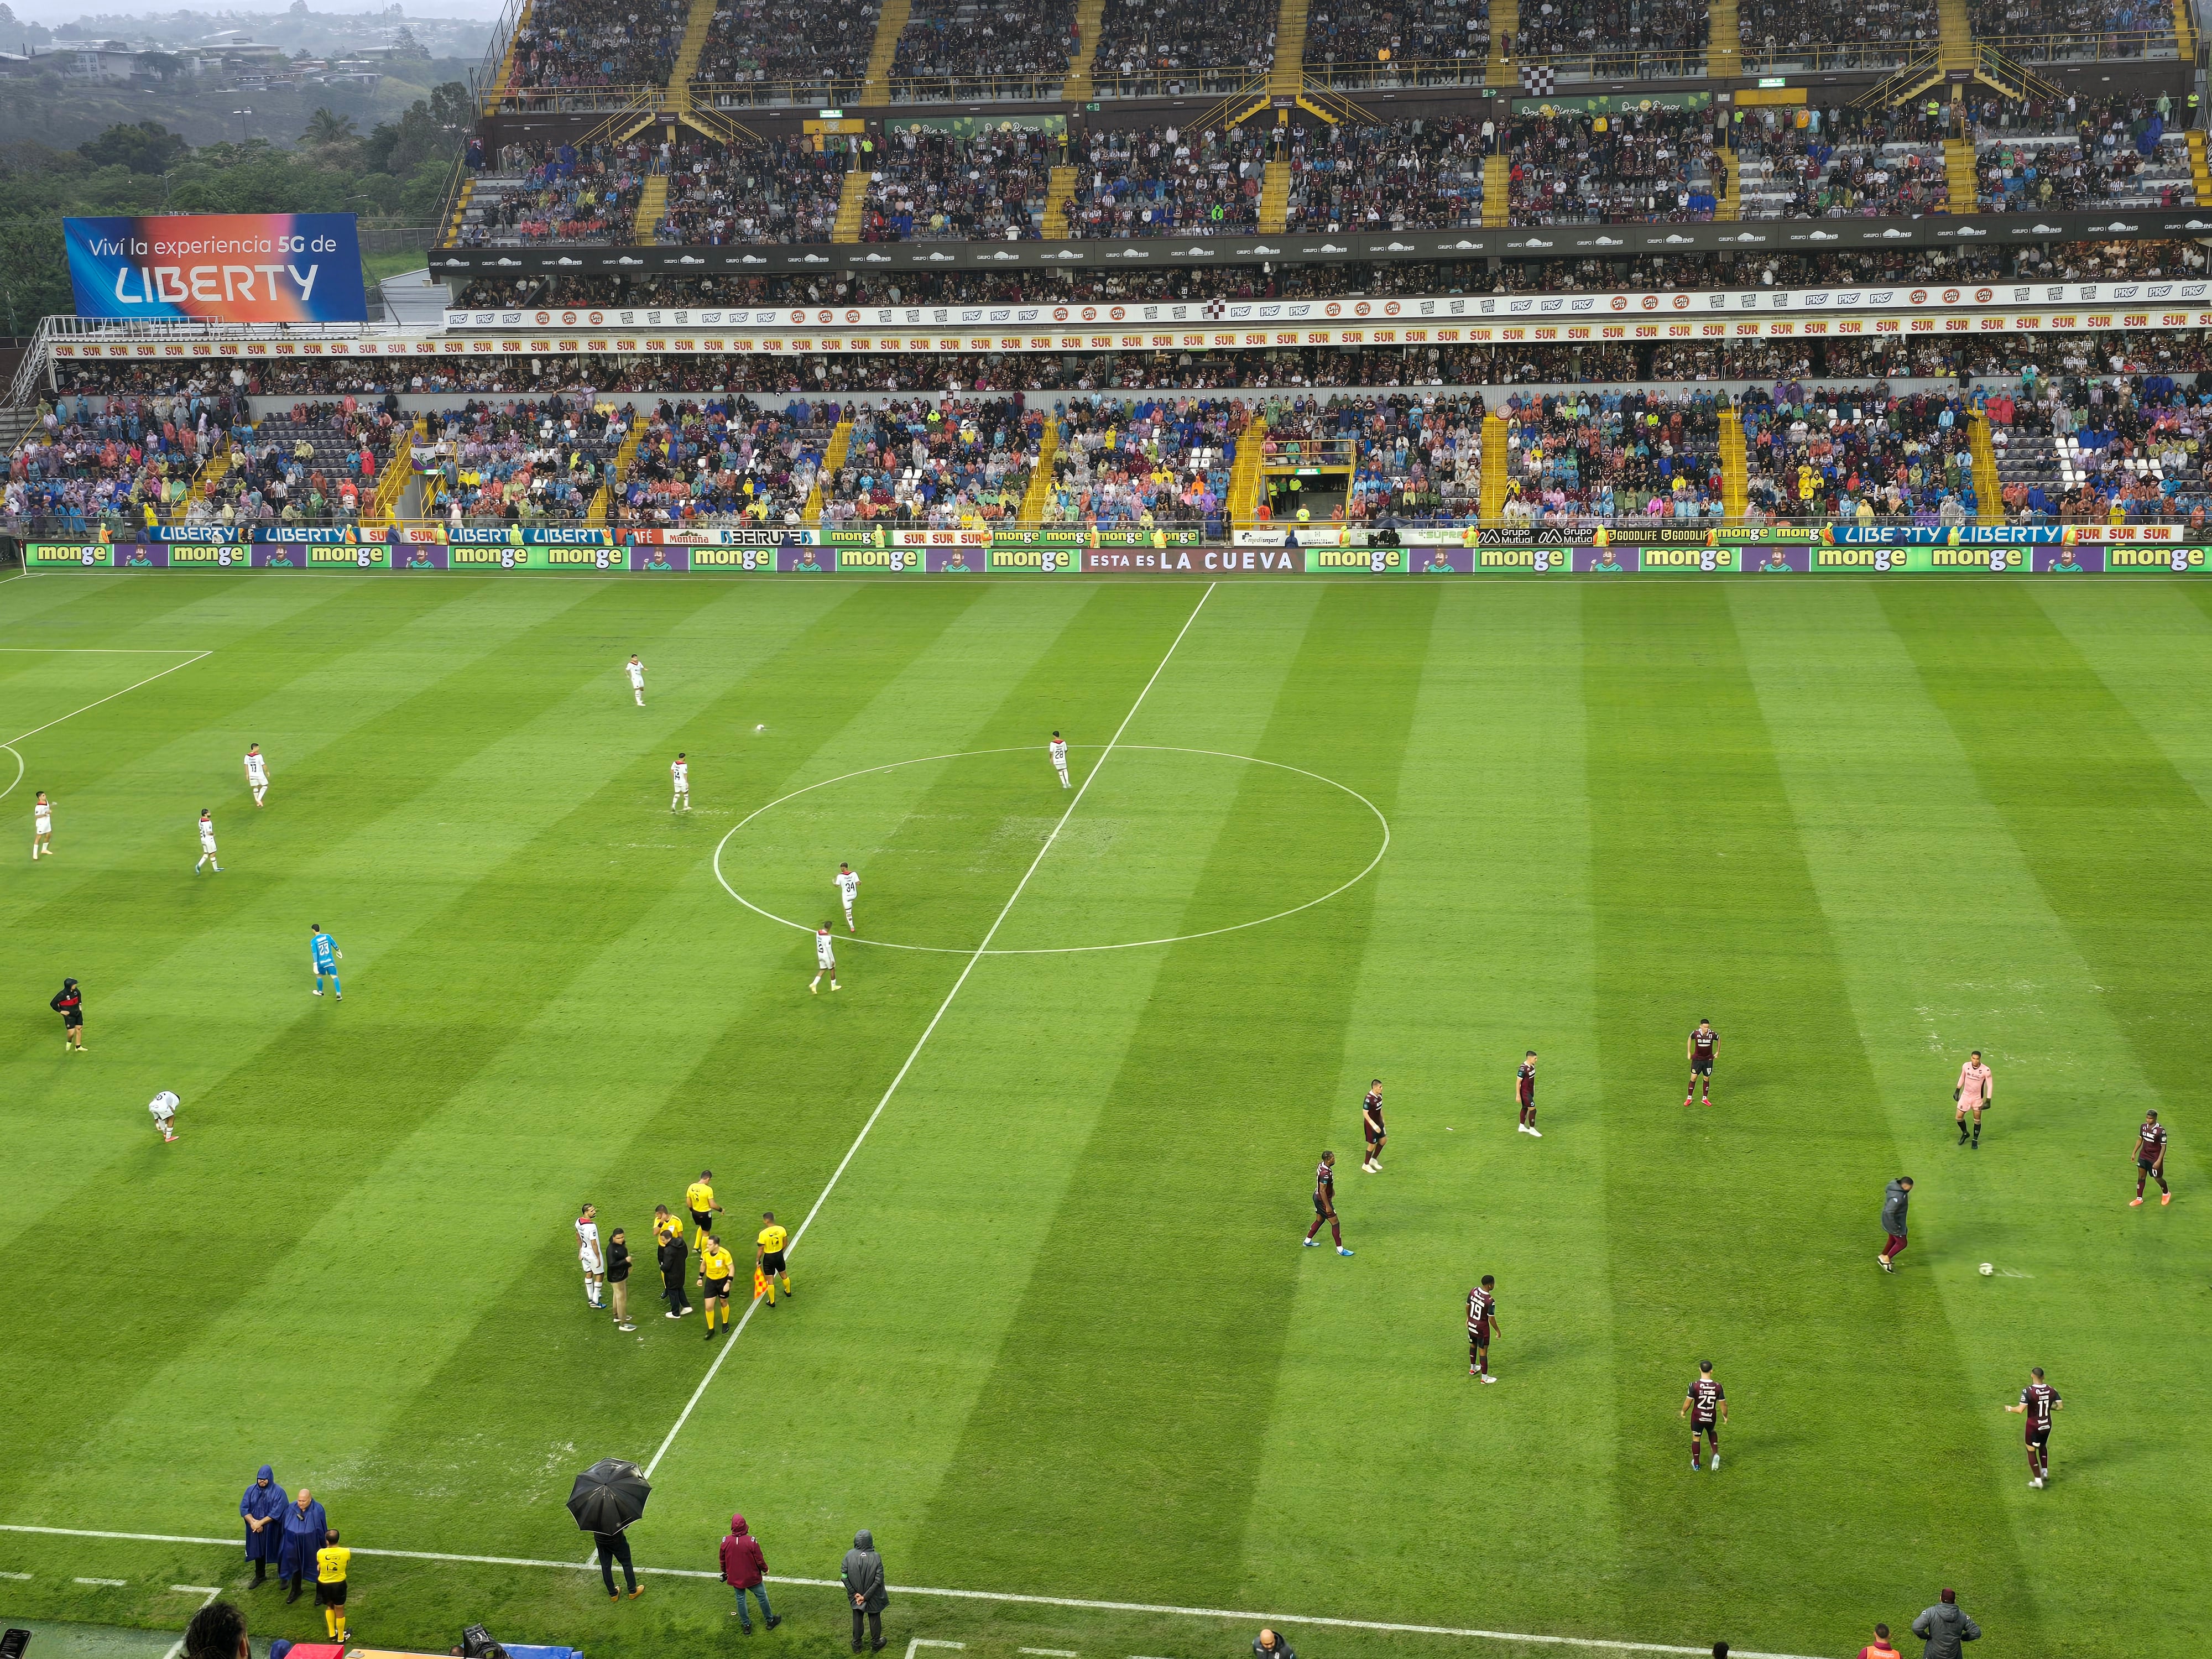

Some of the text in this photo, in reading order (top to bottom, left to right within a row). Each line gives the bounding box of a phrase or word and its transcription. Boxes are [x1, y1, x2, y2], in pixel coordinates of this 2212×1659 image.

[985, 123, 1001, 132] Ds
[89, 235, 336, 258] Viví la experiencia 5G de
[116, 264, 319, 303] LIBERTY
[1946, 320, 1968, 330] SUR
[2016, 319, 2038, 328] SUR
[2088, 317, 2110, 327] SUR
[2163, 315, 2186, 326] SUR
[1669, 326, 1690, 336] SUR
[1737, 325, 1758, 335] SUR
[1804, 324, 1826, 333] SUR
[1876, 321, 1898, 331] SUR
[1342, 333, 1361, 342] SUR
[1406, 331, 1426, 341] SUR
[1470, 331, 1490, 341] SUR
[1535, 329, 1556, 339] SUR
[1603, 328, 1623, 338] SUR
[1031, 338, 1050, 348] SUR
[1092, 338, 1110, 347] SUR
[1152, 336, 1172, 346] SUR
[1215, 336, 1234, 345] SUR
[1277, 334, 1296, 344] SUR
[275, 344, 294, 354] SUR
[331, 343, 348, 354] SUR
[445, 343, 462, 352] SUR
[503, 342, 520, 351] SUR
[560, 342, 577, 351] SUR
[617, 341, 635, 350] SUR
[675, 341, 693, 350] SUR
[734, 341, 752, 351] SUR
[792, 341, 810, 350] SUR
[851, 340, 869, 349] SUR
[910, 340, 928, 349] SUR
[971, 340, 990, 349] SUR
[56, 346, 74, 356] SUR
[110, 346, 128, 356] SUR
[165, 346, 182, 356] SUR
[220, 345, 238, 355] SUR
[265, 527, 346, 541] LIBERTY
[410, 531, 433, 541] SUR
[449, 529, 524, 542] LIBERT
[534, 529, 603, 542] LIBERT
[634, 530, 653, 544] AFÉ
[733, 531, 801, 544] BEIRUE
[832, 531, 875, 544] monge
[995, 531, 1039, 544] monge
[1046, 531, 1091, 544] monge
[1100, 531, 1142, 544] monge
[1150, 531, 1196, 544] onge
[1501, 529, 1530, 537] Grupo
[1563, 528, 1592, 537] Grupo
[1617, 531, 1657, 541] GOODLIFE
[1672, 531, 1706, 540] GOODLIF
[1717, 528, 1768, 541] monge
[1959, 526, 2059, 542] LIBERTY
[2077, 529, 2099, 539] SUR
[2109, 529, 2134, 539] SUR
[2143, 529, 2168, 539] SUR
[904, 533, 925, 544] SUR
[932, 533, 952, 544] SUR
[961, 533, 981, 544] SUR
[38, 546, 106, 566] monge
[174, 546, 244, 566] monge
[311, 546, 383, 567] monge
[454, 547, 528, 568] monge
[548, 548, 623, 569] monge
[694, 549, 769, 571] monge
[842, 550, 917, 571] monge
[1091, 552, 1293, 569] ESTA ES LA CUEVA
[1318, 550, 1400, 572] monge
[1481, 550, 1564, 571] monge
[1645, 549, 1732, 571] monge
[1818, 549, 1907, 571] monge
[1932, 549, 2023, 571] monge
[2111, 548, 2205, 571] monge
[992, 551, 1070, 572] monge
[845, 882, 854, 892] 34
[1470, 1301, 1482, 1321] 19
[1697, 1395, 1717, 1410] 25
[2037, 1400, 2049, 1417] 11
